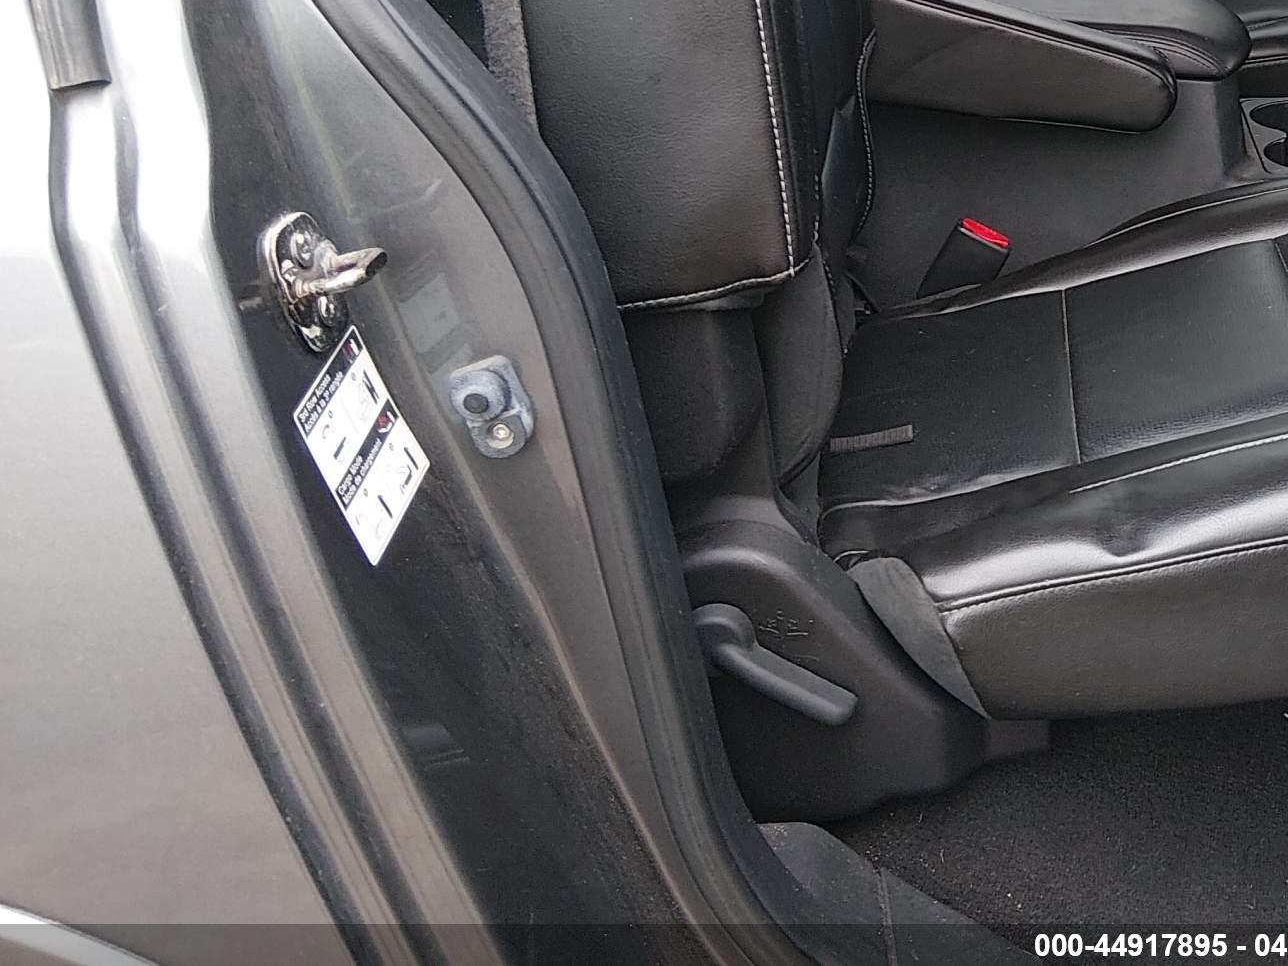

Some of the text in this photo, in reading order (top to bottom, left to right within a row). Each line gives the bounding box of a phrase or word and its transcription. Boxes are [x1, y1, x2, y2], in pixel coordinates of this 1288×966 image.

[299, 374, 330, 422] 3rd Row Access
[338, 455, 363, 495] Cargo Mode
[342, 485, 356, 504] Mode
[360, 437, 382, 476] chargement
